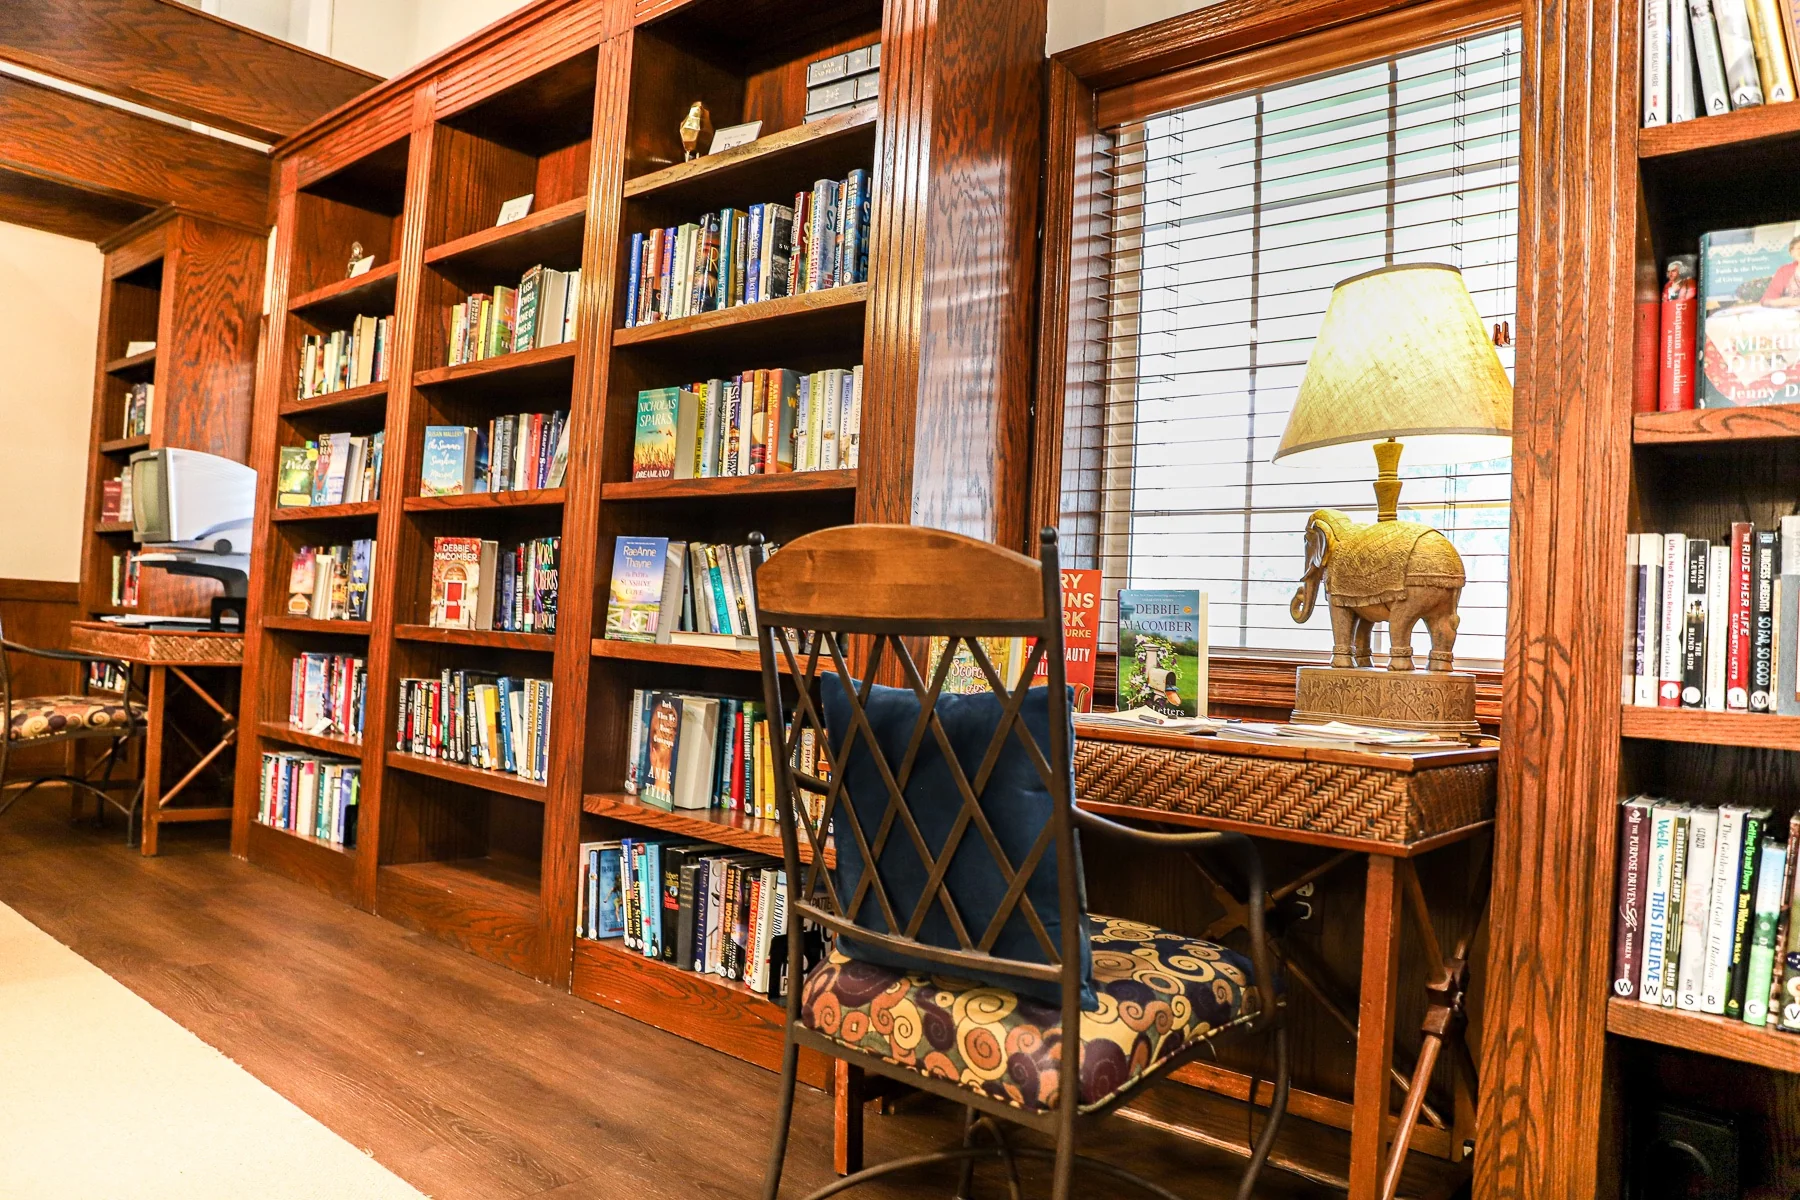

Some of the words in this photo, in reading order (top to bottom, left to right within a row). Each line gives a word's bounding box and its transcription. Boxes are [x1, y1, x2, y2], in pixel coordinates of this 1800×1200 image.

[1775, 88, 1785, 97] A
[1648, 112, 1657, 122] A
[1674, 303, 1687, 348] Benjamin
[1673, 352, 1687, 394] Franklin
[730, 386, 740, 420] Silva
[1730, 386, 1777, 401] Jenny
[638, 399, 677, 413] NICHOLAS
[639, 412, 673, 427] SPARKS
[1742, 533, 1750, 542] THE
[434, 552, 478, 561] MACOMBER
[442, 543, 470, 553] DEBBIE
[537, 542, 554, 564] NORA
[623, 545, 657, 557] RaeAnne
[626, 557, 652, 569] Thayne
[1741, 544, 1750, 572] RIDE
[1759, 548, 1771, 579] BURGESS
[1060, 573, 1084, 589] RY
[1697, 555, 1705, 588] MICHAEL
[535, 568, 558, 596] ROBERTS
[1740, 582, 1749, 606] HER
[1759, 580, 1771, 612] MEREDITH
[1136, 604, 1180, 614] DEBBIE
[1062, 611, 1087, 628] RK
[1123, 620, 1192, 632] MACOMBER
[1740, 611, 1748, 636] LIFE
[1758, 616, 1771, 628] SO
[1065, 629, 1092, 638] URKE
[1755, 629, 1770, 646] FAR,
[1063, 647, 1090, 662] EAUTY
[1757, 647, 1768, 660] SO
[952, 659, 1001, 679] Scorcd
[1756, 661, 1769, 685] GOOD
[1753, 695, 1766, 705] M
[499, 697, 507, 727] PICOULT
[1153, 705, 1185, 716] Letters
[648, 766, 671, 784] ANNE
[645, 783, 671, 803] TYLER
[1656, 819, 1670, 849] Welk
[1722, 823, 1732, 842] The
[1745, 820, 1758, 847] Getting
[1628, 836, 1639, 871] PURPOSE
[1675, 827, 1685, 862] NEBRASKA
[1743, 846, 1755, 856] Up
[1719, 844, 1731, 875] Golden
[1744, 857, 1753, 870] and
[1674, 863, 1683, 878] POW
[1741, 870, 1752, 890] Down
[1626, 872, 1638, 904] DRIVEN
[1672, 879, 1681, 903] CAMPS
[1717, 877, 1728, 894] Era
[751, 883, 759, 910] JAMES
[774, 893, 785, 919] BEACH
[1651, 892, 1665, 920] THIS
[1716, 895, 1727, 905] of
[1739, 893, 1750, 908] Tom
[758, 892, 766, 921] PATTERSON
[634, 909, 642, 936] Straw
[724, 903, 732, 933] WOODS
[1713, 907, 1726, 928] Golf
[1736, 908, 1749, 934] Watson
[747, 912, 756, 961] PATTERSON
[772, 920, 782, 938] ROA
[1624, 933, 1632, 959] WARREN
[1712, 935, 1721, 945] Al
[1647, 932, 1663, 982] BELIEVE
[1666, 962, 1676, 986] MARSH
[1618, 982, 1632, 992] W
[1644, 985, 1658, 996] W
[1685, 995, 1694, 1005] S
[1707, 995, 1715, 1005] B
[1748, 1004, 1756, 1014] C
